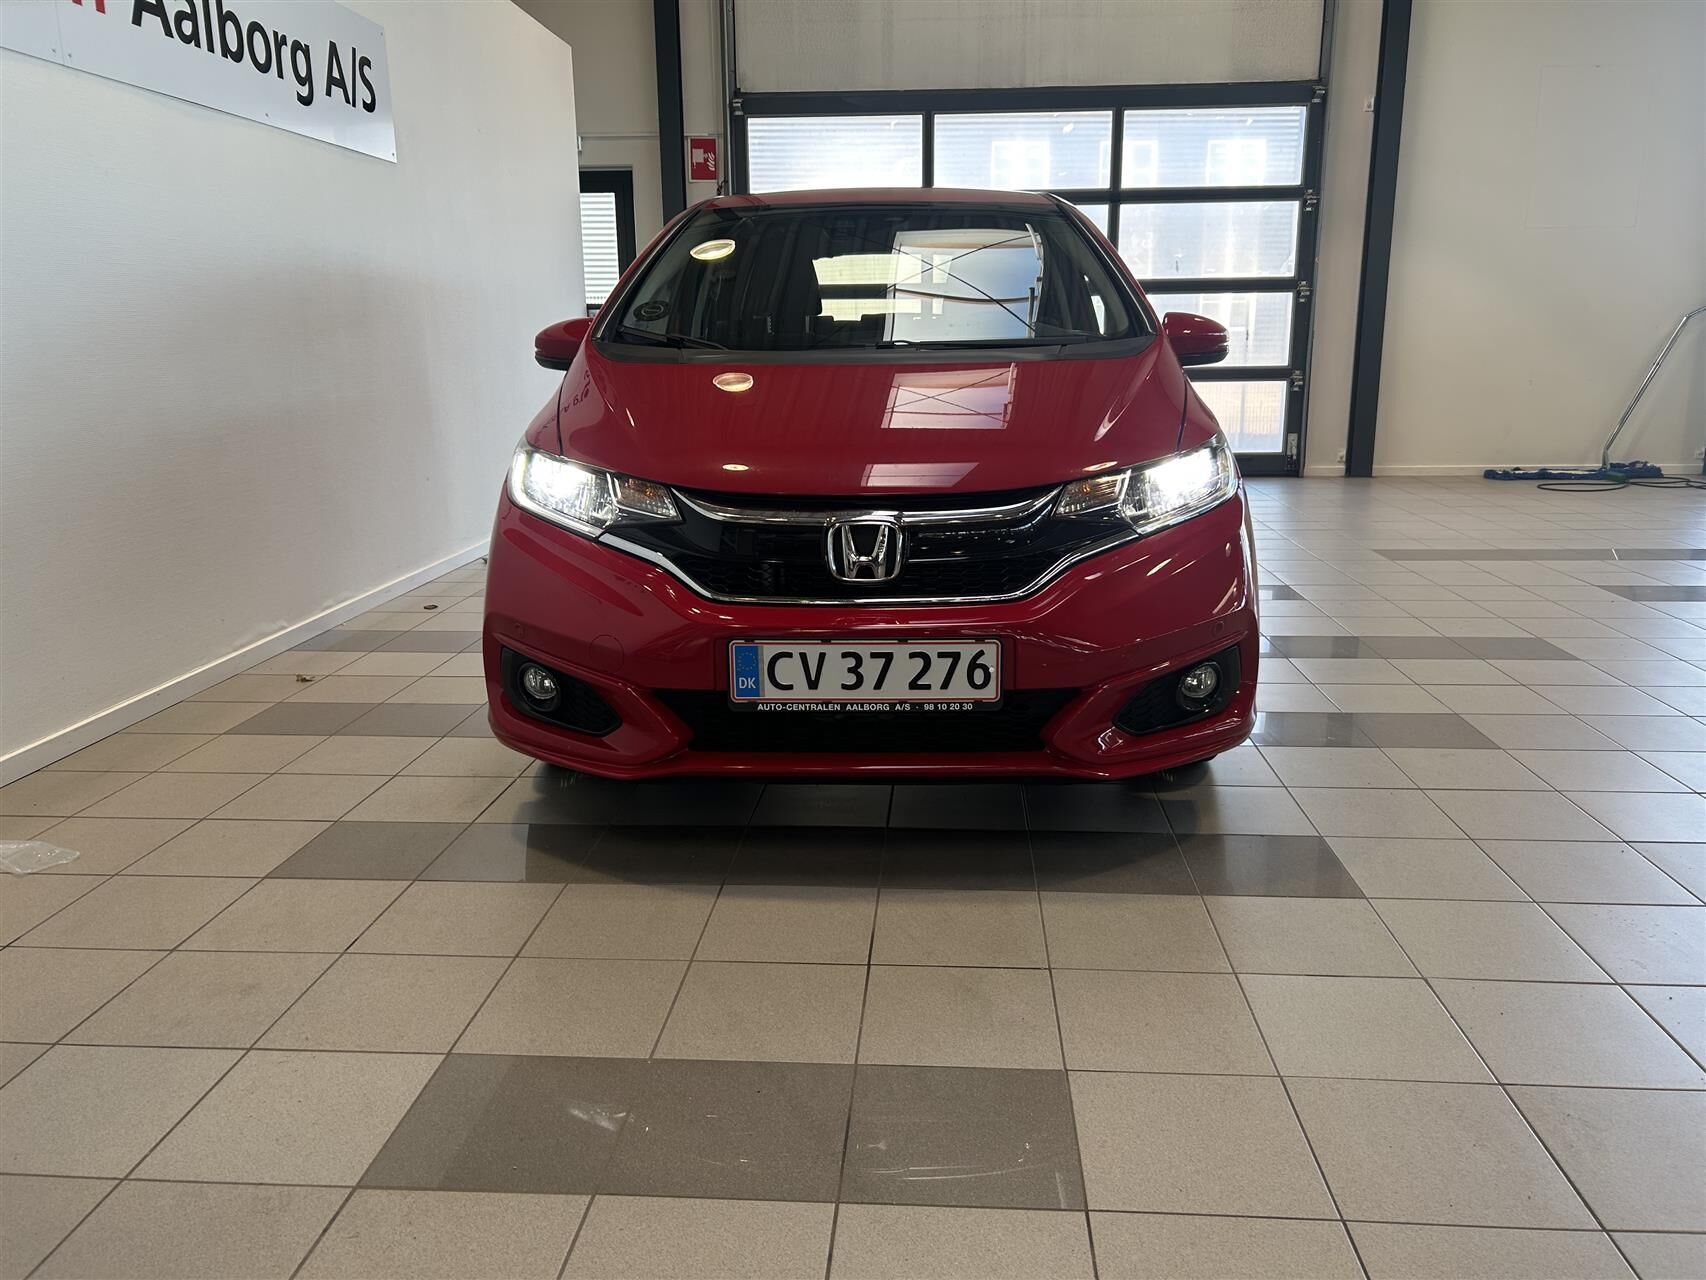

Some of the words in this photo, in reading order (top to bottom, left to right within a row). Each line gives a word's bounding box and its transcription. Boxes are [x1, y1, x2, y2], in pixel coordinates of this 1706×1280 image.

[767, 651, 826, 690] CV
[841, 651, 894, 690] 37
[908, 650, 991, 690] 276
[738, 677, 757, 689] DK
[757, 703, 841, 711] AUTO-CENTRALEN
[845, 703, 890, 711] AALBORG
[895, 703, 911, 711] A/S
[923, 703, 935, 711] 98
[937, 703, 948, 711] 10
[949, 703, 960, 711] 20
[962, 703, 973, 711] 30
